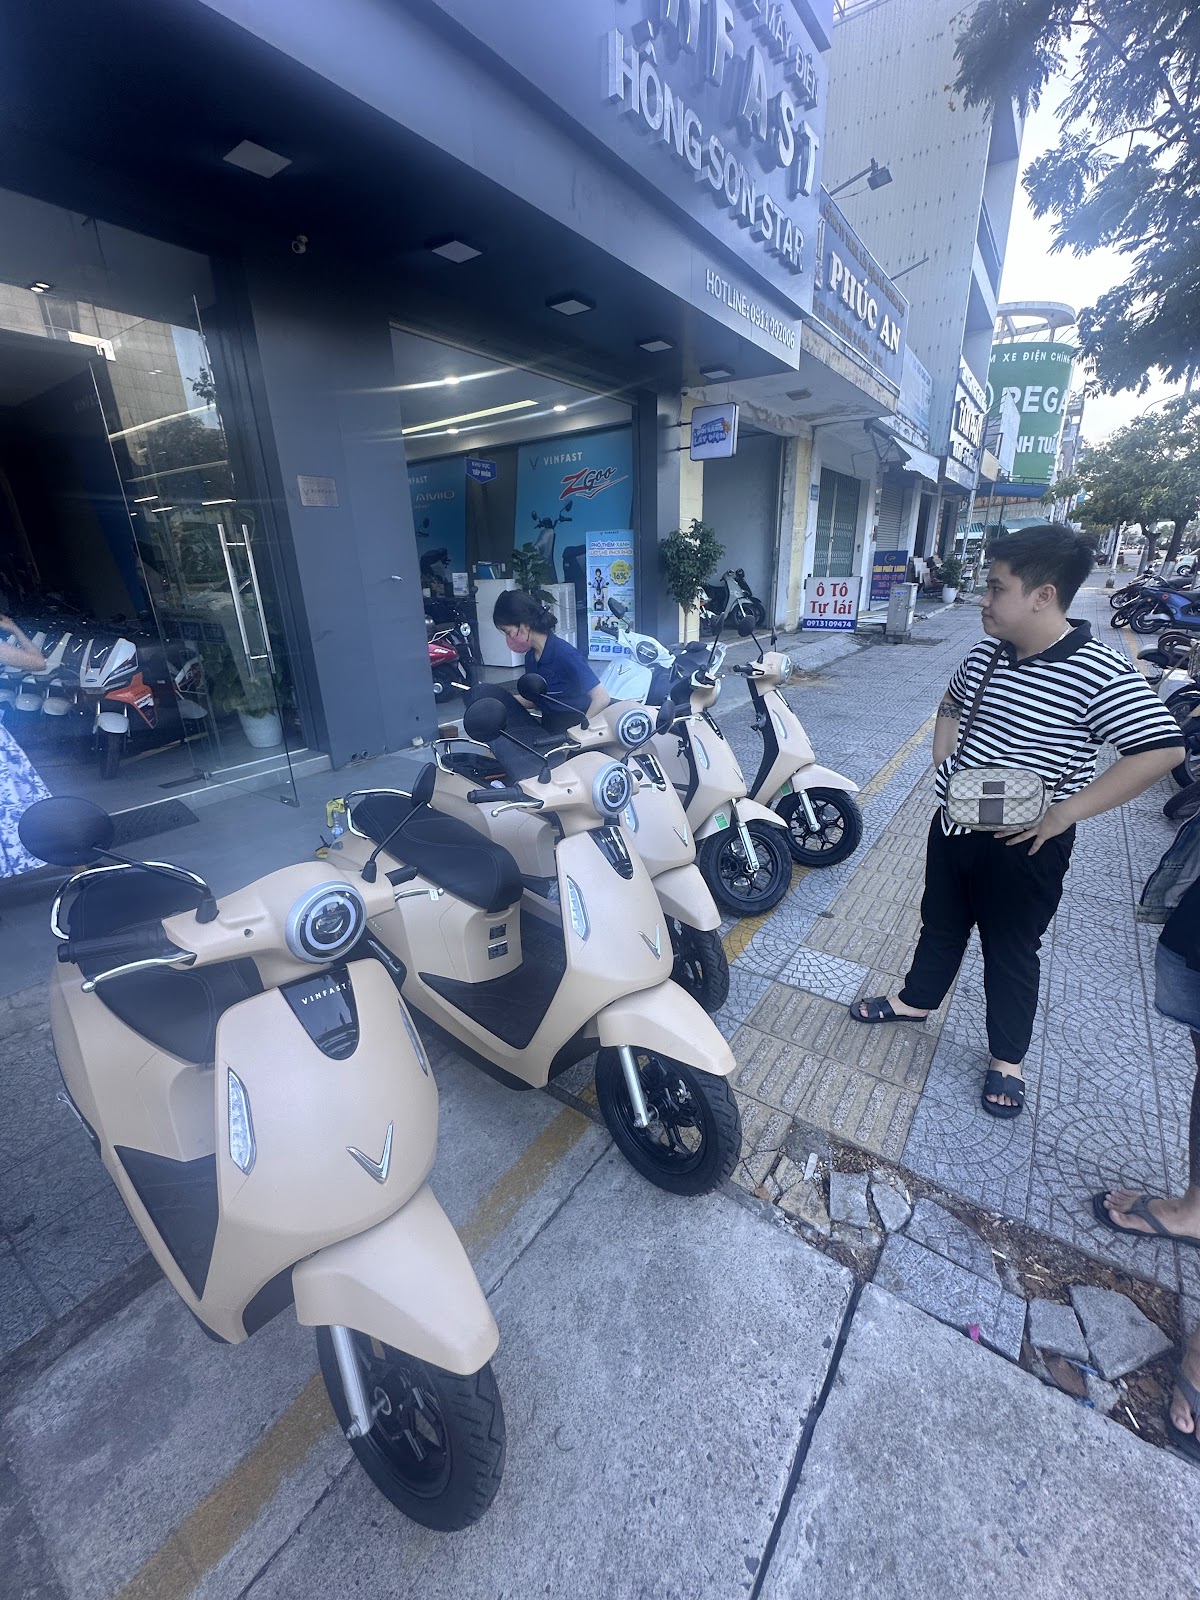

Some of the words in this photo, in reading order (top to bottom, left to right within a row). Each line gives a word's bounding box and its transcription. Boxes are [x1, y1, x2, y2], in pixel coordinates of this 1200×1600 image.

[608, 20, 702, 171] HỒNG
[707, 134, 757, 225] SƠN
[761, 193, 804, 271] STAR
[706, 268, 750, 319] HOTLINE:
[830, 251, 879, 331] PHÚC
[880, 314, 901, 355] AN
[1003, 352, 1017, 362] XE
[1023, 350, 1046, 363] ĐIỆN
[543, 452, 583, 466] VINFAST
[809, 600, 830, 617] Tự
[833, 600, 853, 615] lái
[806, 620, 852, 628] 0913109474
[301, 983, 347, 1005] VINFAST
